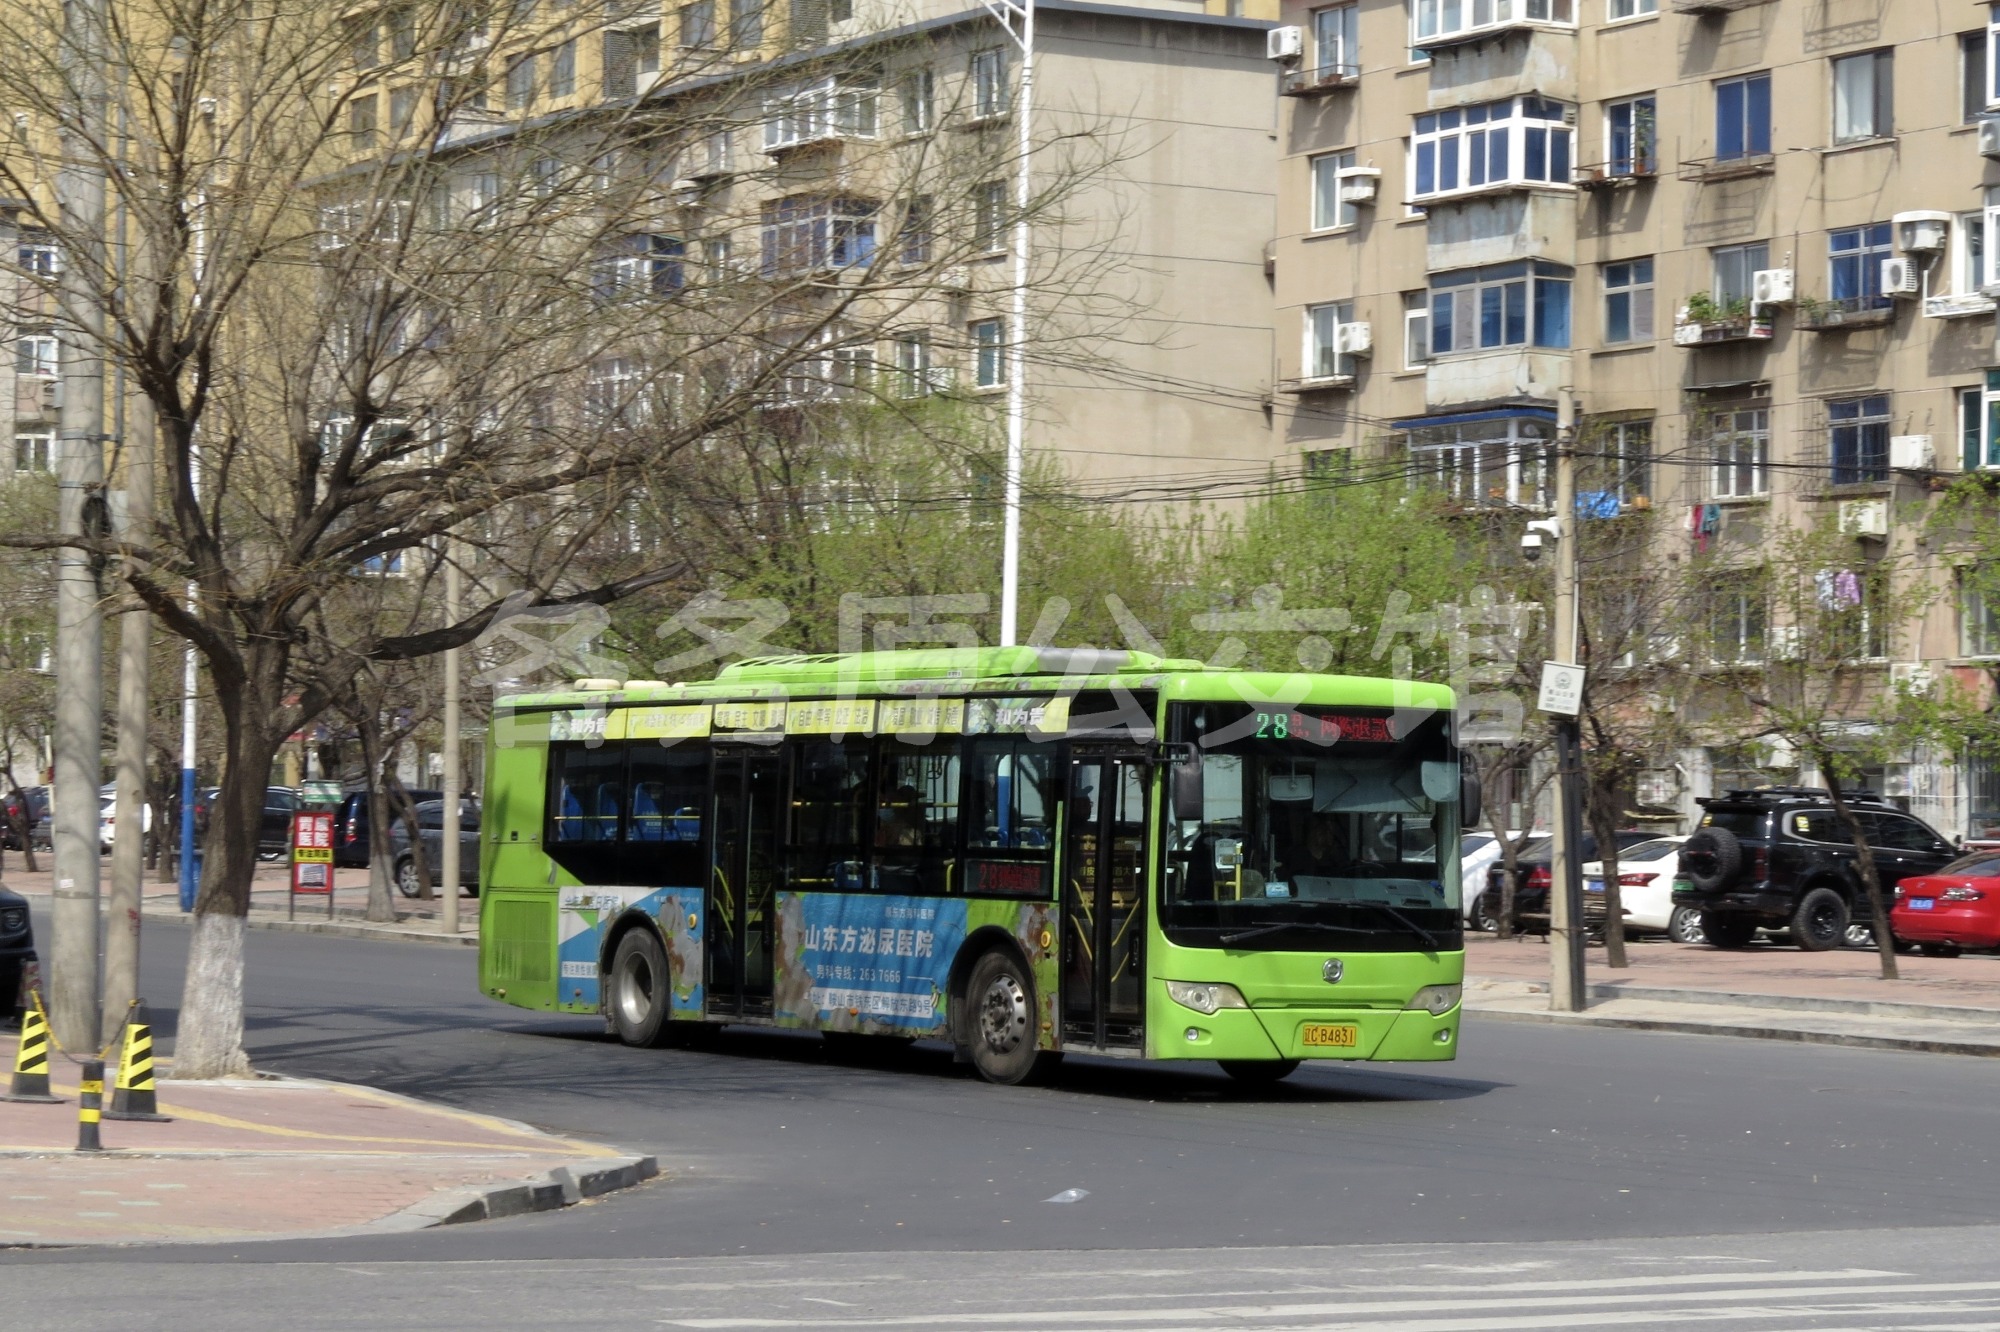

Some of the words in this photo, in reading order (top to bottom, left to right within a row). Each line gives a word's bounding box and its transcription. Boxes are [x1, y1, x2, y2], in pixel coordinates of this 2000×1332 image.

[995, 706, 1045, 727] 和为贵
[1256, 713, 1288, 739] 28
[805, 923, 934, 958] 山东方泌尿医院
[879, 969, 901, 983] 7666
